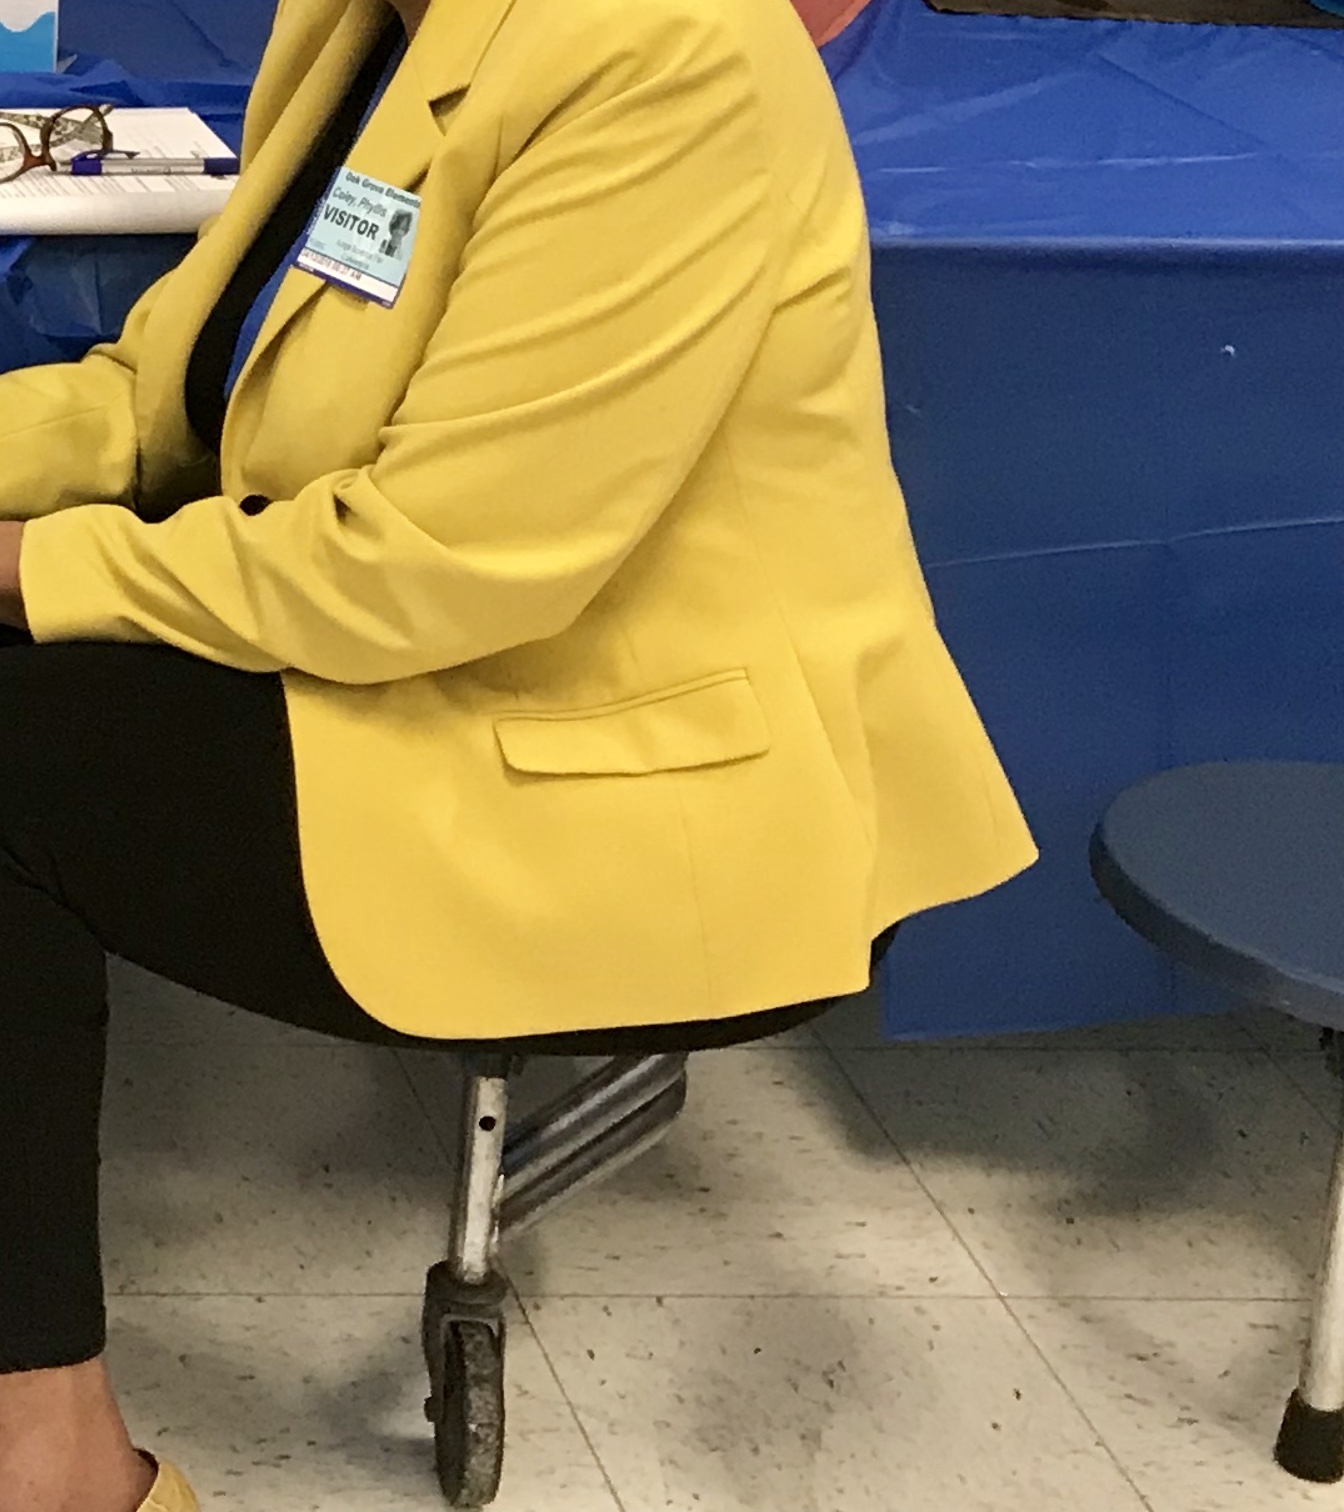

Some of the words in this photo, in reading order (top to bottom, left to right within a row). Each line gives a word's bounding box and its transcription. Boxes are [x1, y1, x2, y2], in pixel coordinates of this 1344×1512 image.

[346, 172, 360, 185] Oak
[362, 179, 384, 193] Grove
[323, 204, 380, 240] VISITOR
